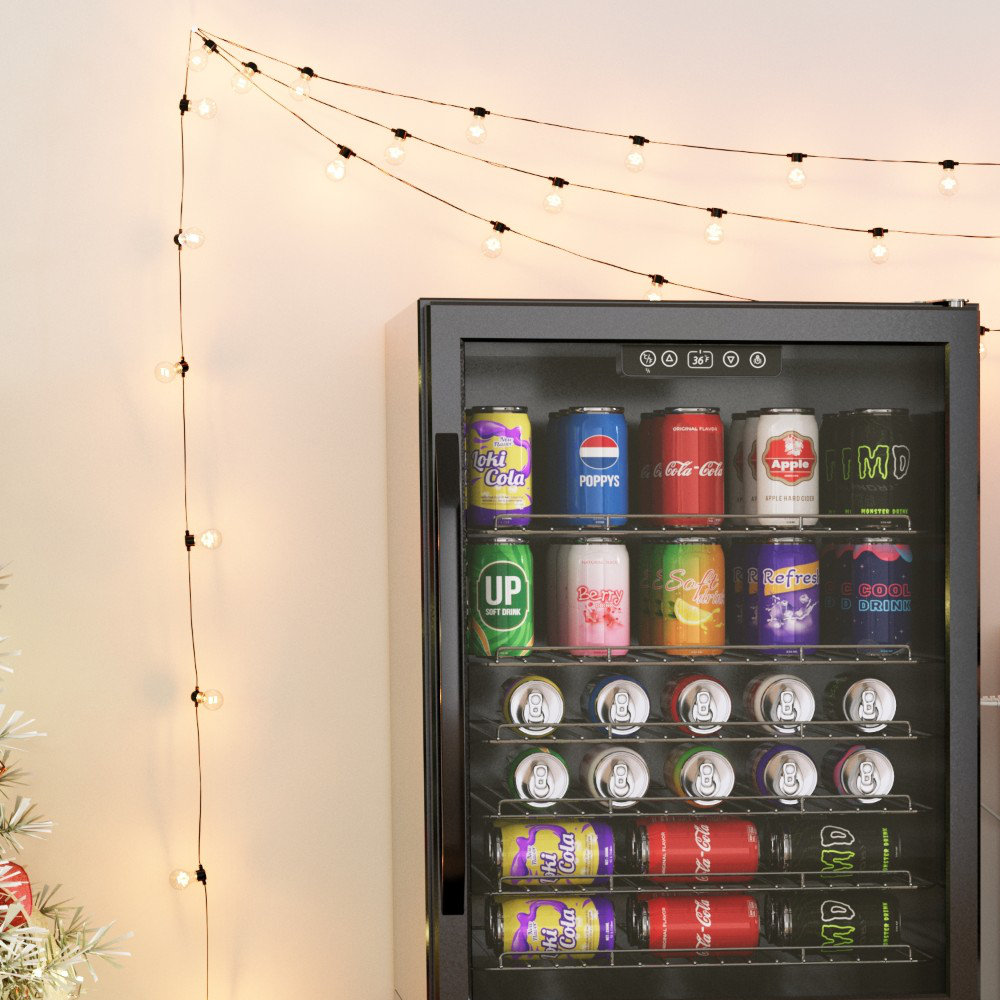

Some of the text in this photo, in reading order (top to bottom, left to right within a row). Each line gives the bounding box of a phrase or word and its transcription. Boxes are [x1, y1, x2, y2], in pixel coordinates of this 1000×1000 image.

[472, 451, 506, 472] Loki
[771, 459, 809, 473] Apple
[485, 469, 525, 486] Cola
[579, 474, 620, 487] POPPYS
[485, 575, 522, 605] UP
[577, 585, 624, 607] Berry
[858, 583, 911, 597] COOL
[485, 608, 521, 616] SOFT DRINK
[858, 599, 912, 612] DRINK
[559, 832, 575, 874] Cola
[559, 908, 576, 949] Cola
